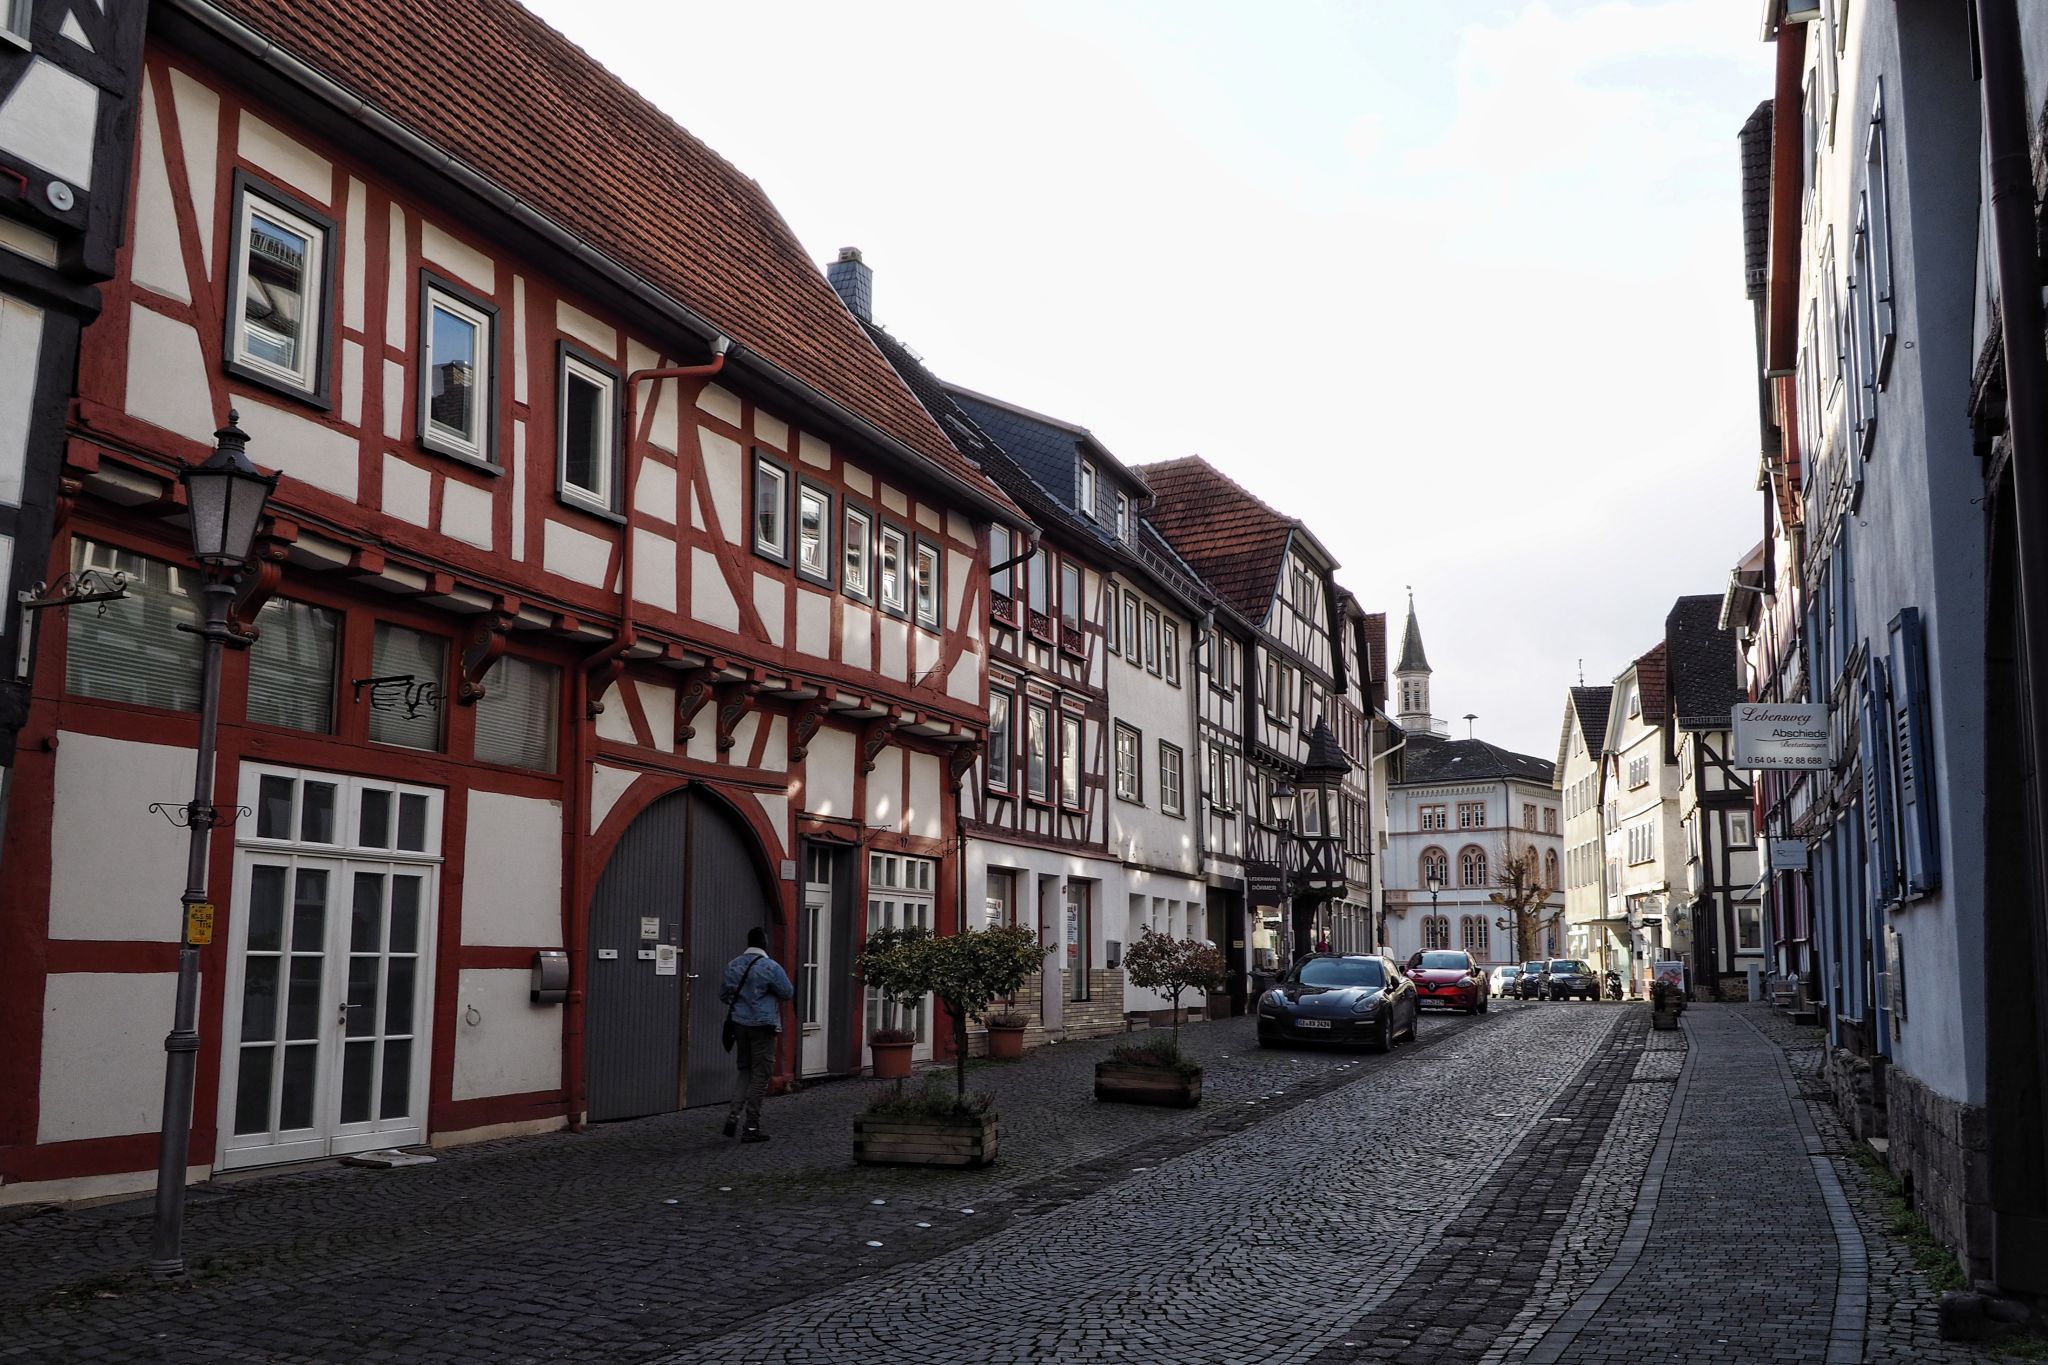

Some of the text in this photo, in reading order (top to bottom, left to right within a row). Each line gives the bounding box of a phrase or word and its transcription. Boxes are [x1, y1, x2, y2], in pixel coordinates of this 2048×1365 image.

[1741, 707, 1811, 725] Lebensweg
[1772, 729, 1827, 738] Abschiede
[1747, 756, 1753, 764] 0
[1754, 756, 1765, 764] 64
[1766, 756, 1777, 764] 04
[1784, 756, 1794, 765] 92
[1796, 756, 1806, 765] 88
[1807, 756, 1823, 765] 688
